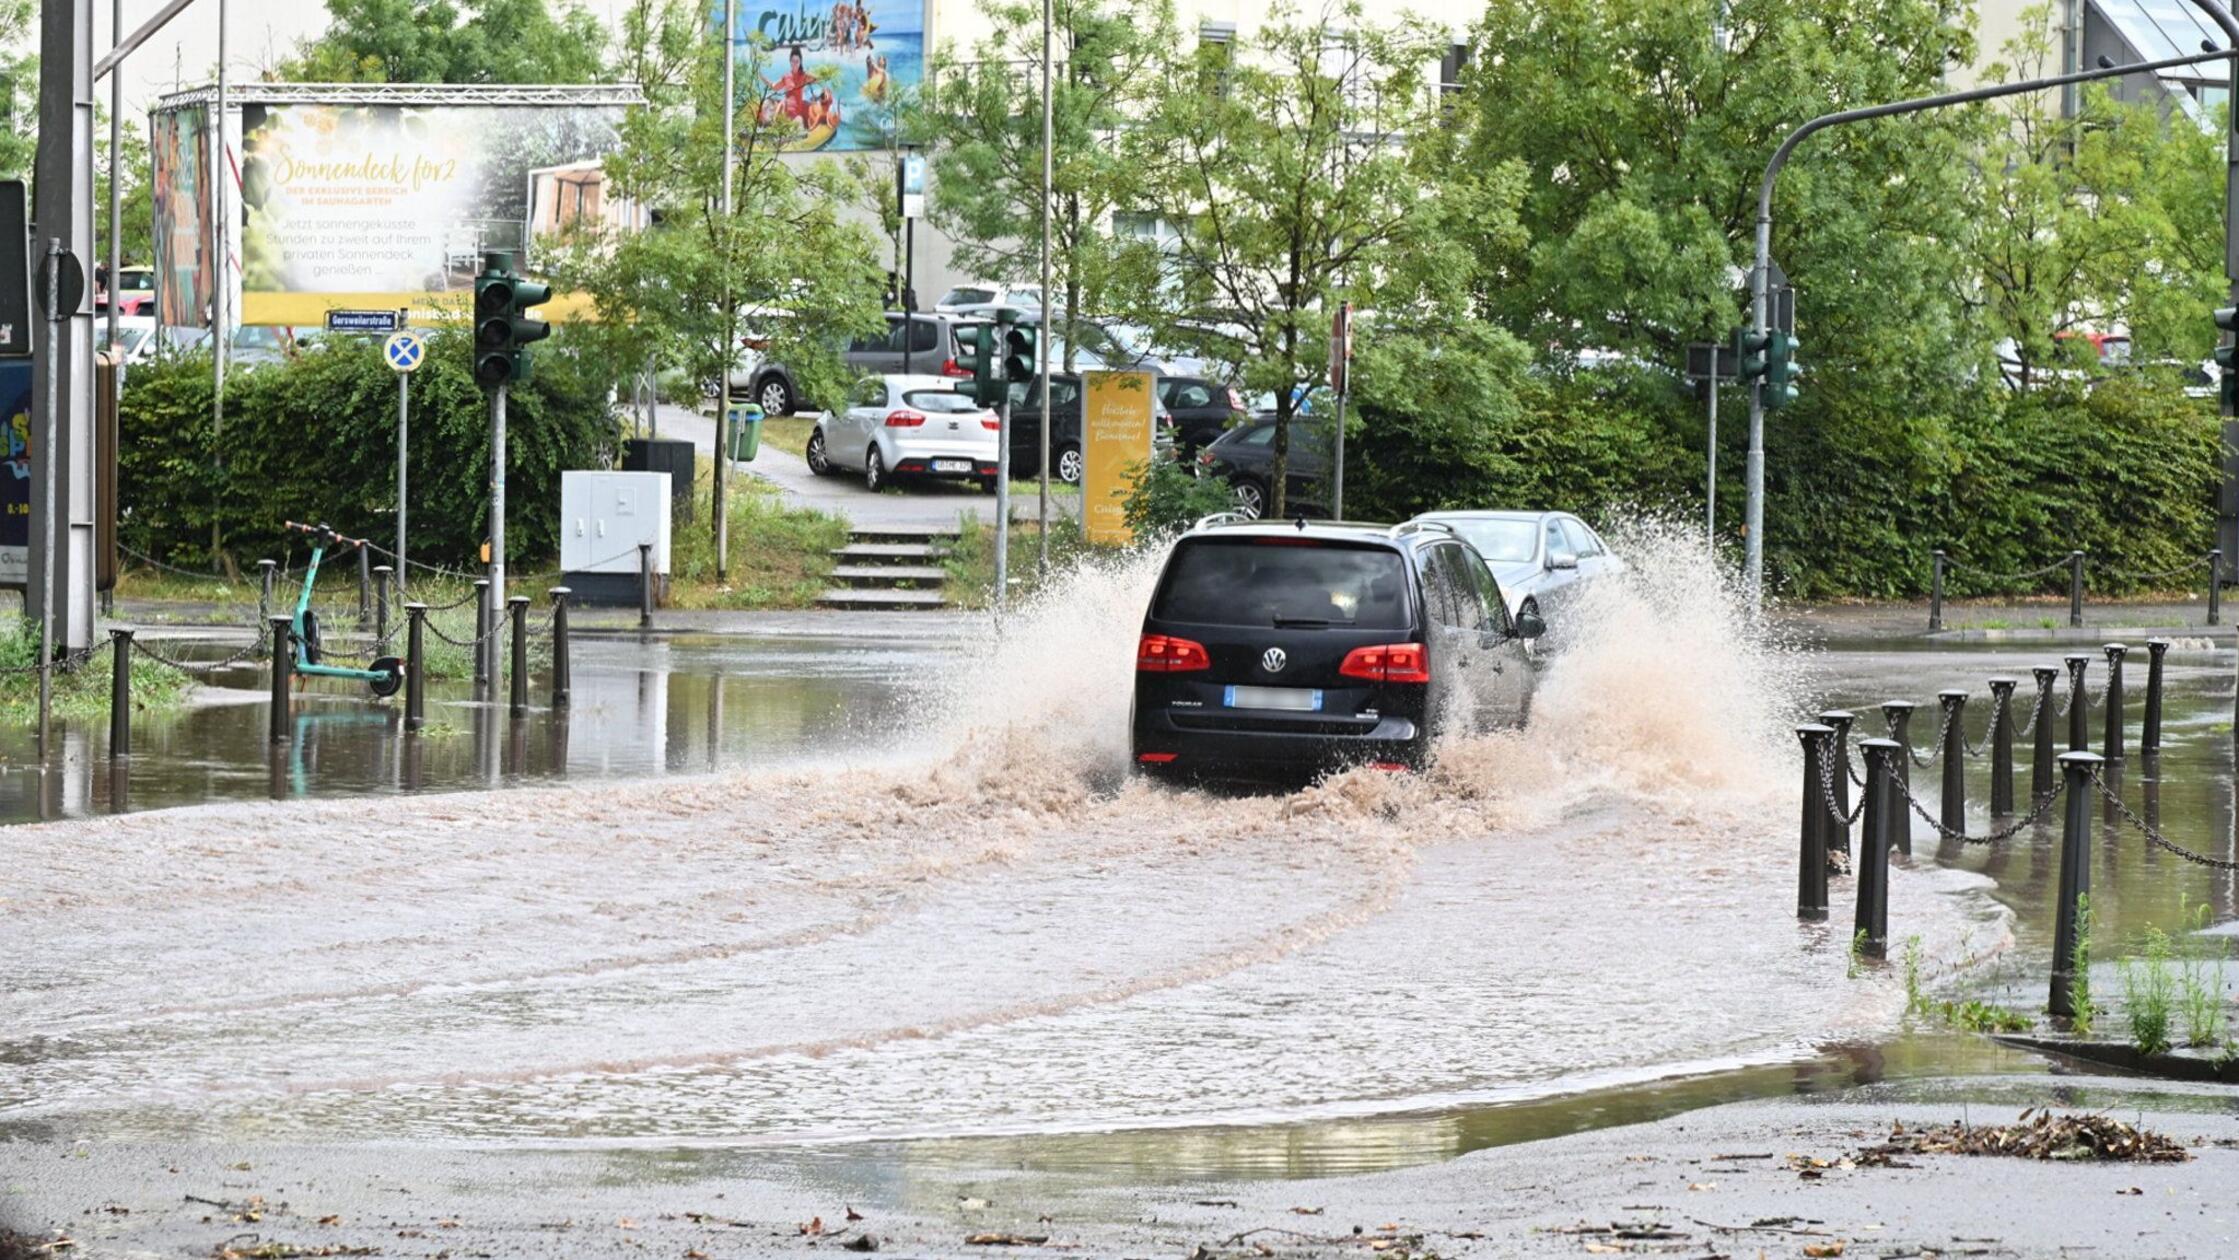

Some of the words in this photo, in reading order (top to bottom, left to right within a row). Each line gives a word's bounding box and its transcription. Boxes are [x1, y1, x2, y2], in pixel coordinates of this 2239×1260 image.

[274, 144, 410, 185] Sonnendeck
[908, 163, 921, 188] P
[286, 187, 306, 195] DER
[308, 187, 363, 195] EXKLUSIVE
[366, 187, 408, 195] BEREICH
[282, 219, 312, 230] Jetzt
[266, 233, 317, 245] Stunden
[320, 236, 335, 245] zu
[338, 234, 369, 245] zweit
[372, 233, 393, 245] auf
[396, 233, 432, 245] Ihrem
[283, 249, 335, 264] privaten
[338, 249, 414, 261] Sonnendeck
[312, 263, 373, 277] genießen
[331, 314, 393, 327] Gersweilerstraße
